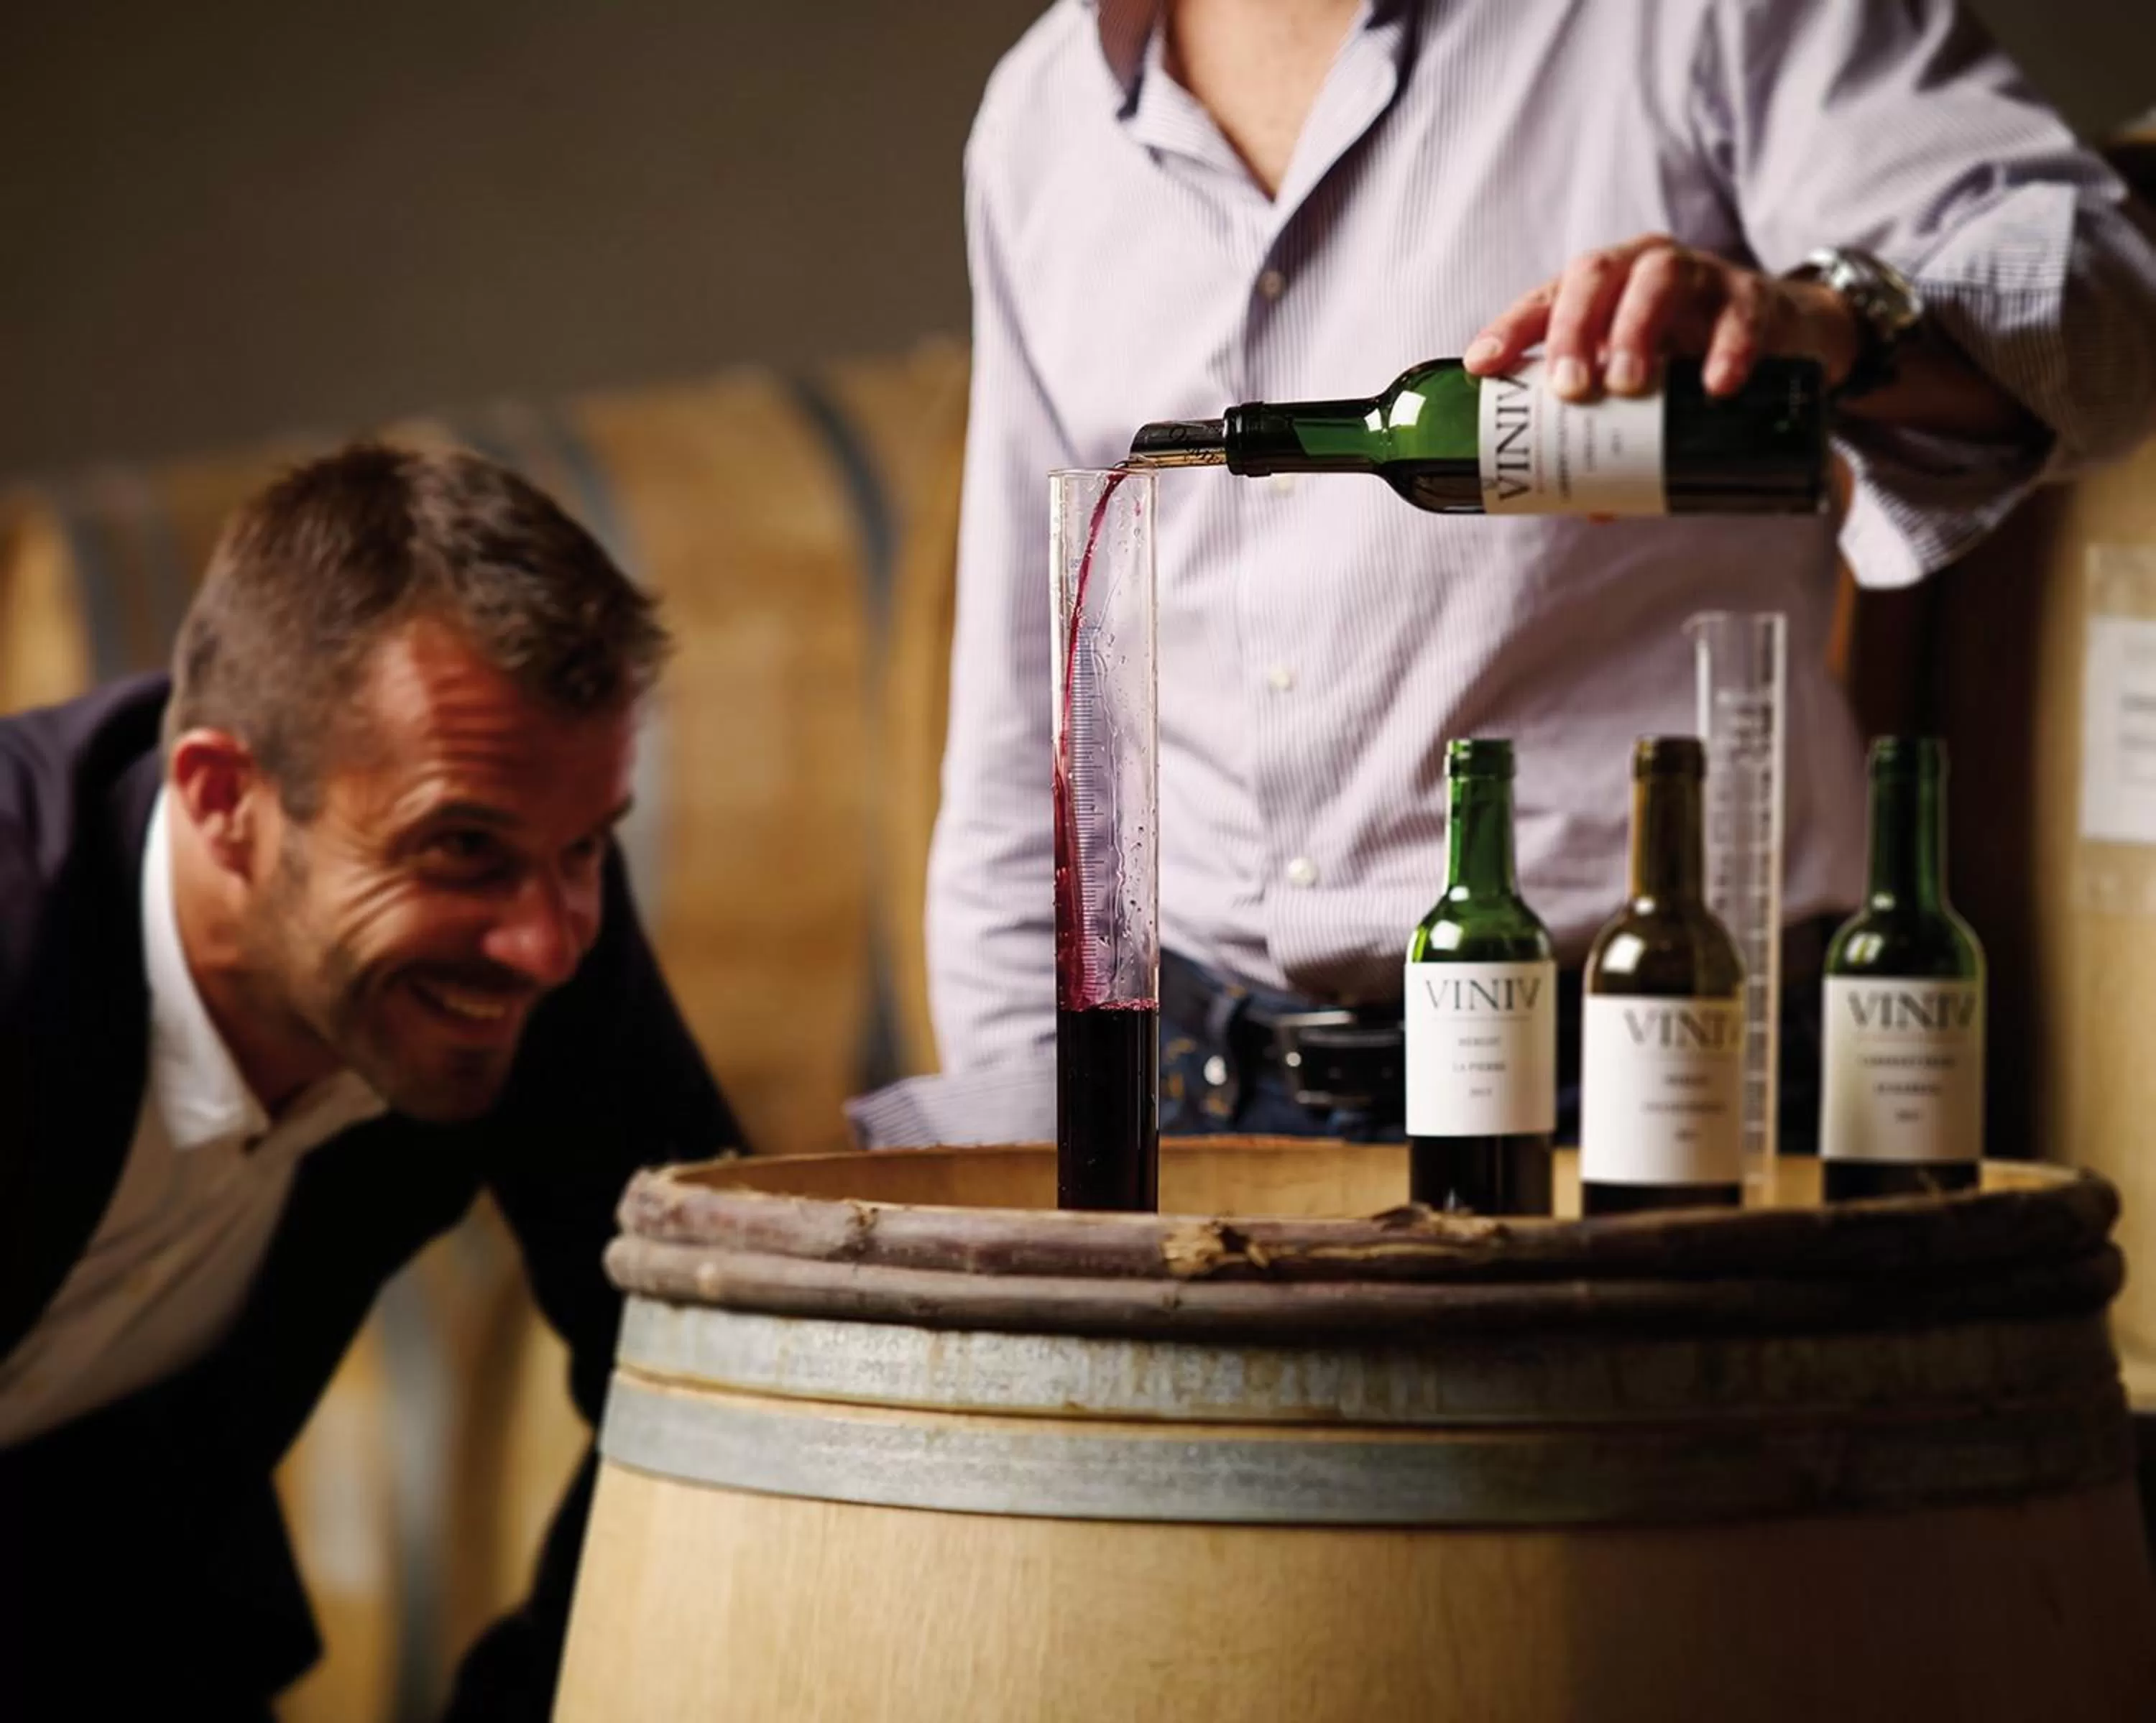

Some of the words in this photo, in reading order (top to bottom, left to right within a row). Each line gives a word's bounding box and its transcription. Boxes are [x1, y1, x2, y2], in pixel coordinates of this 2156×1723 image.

[1496, 374, 1532, 502] VINIV
[1425, 978, 1542, 1011] VINIV
[1846, 991, 1976, 1030] VINIV
